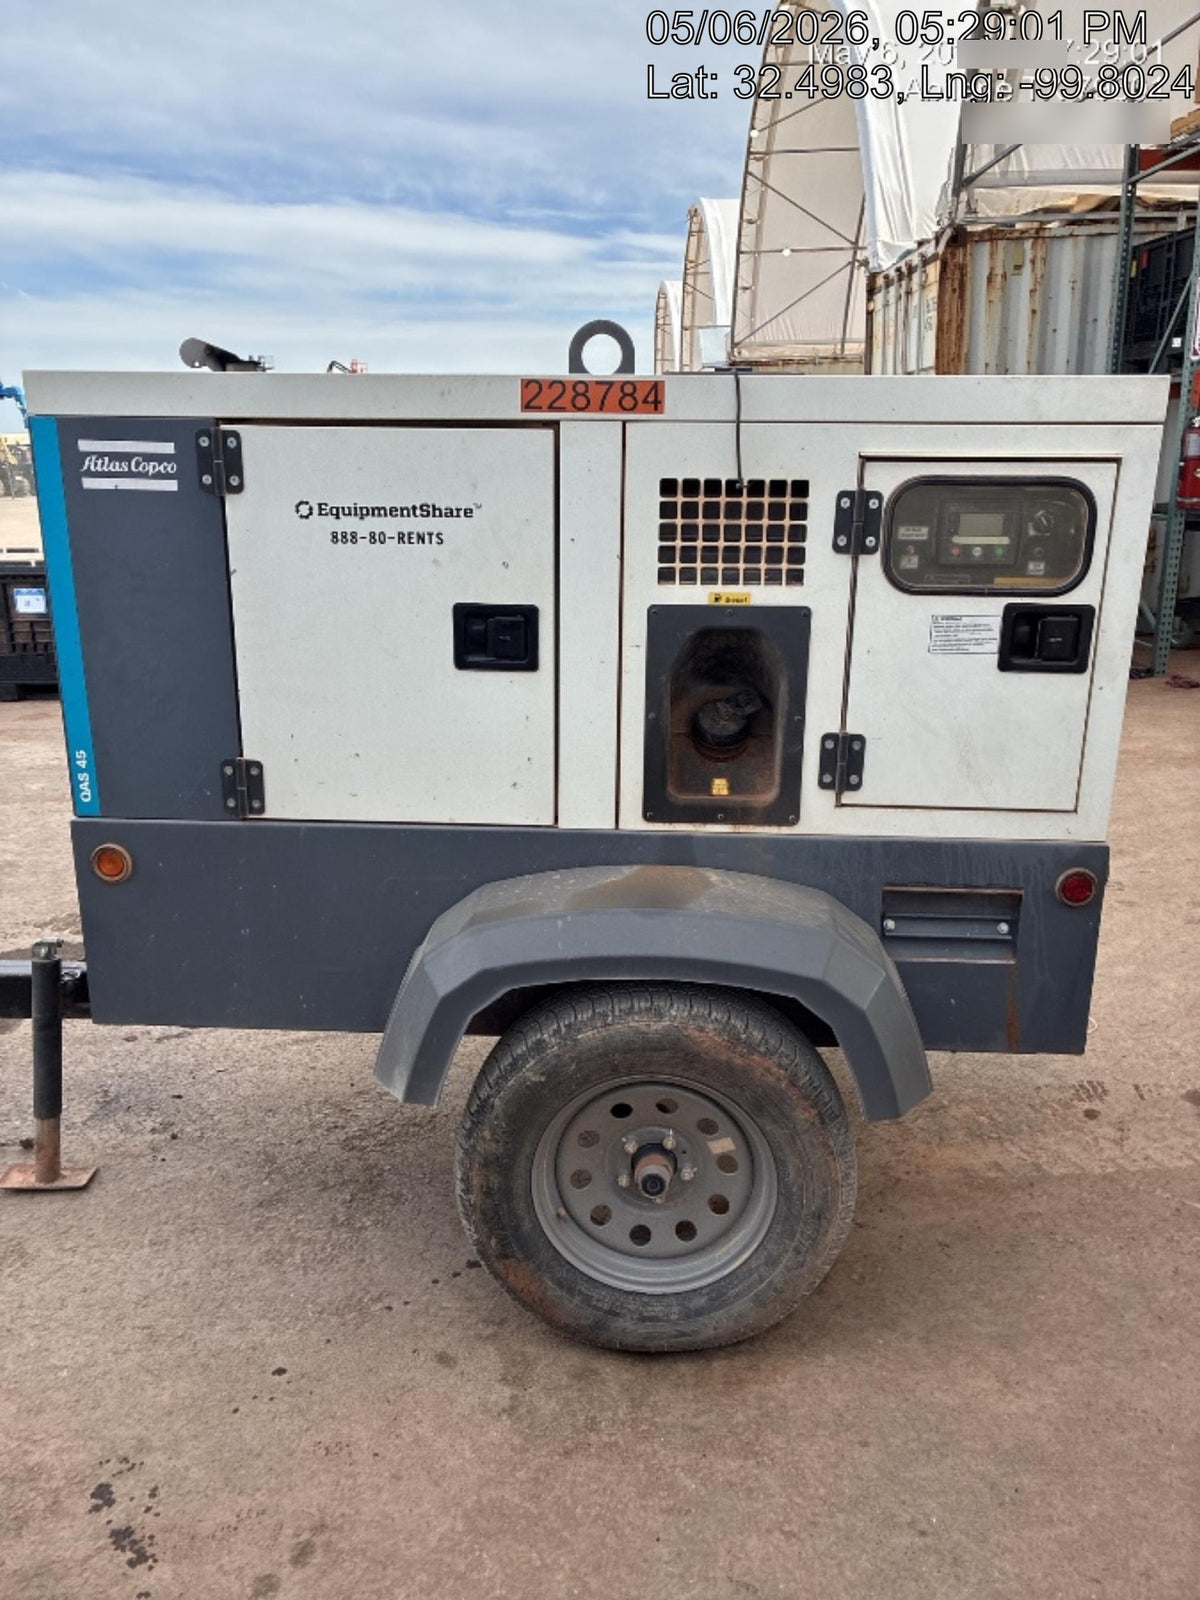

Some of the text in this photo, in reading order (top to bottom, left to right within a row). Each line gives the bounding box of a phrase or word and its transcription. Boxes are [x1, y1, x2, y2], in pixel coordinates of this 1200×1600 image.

[523, 379, 662, 411] 228784
[80, 455, 177, 476] Atlas Copco
[316, 502, 474, 520] EquipmentShare
[330, 531, 444, 545] 888-80-RENTS
[75, 750, 91, 802] QAS 45
